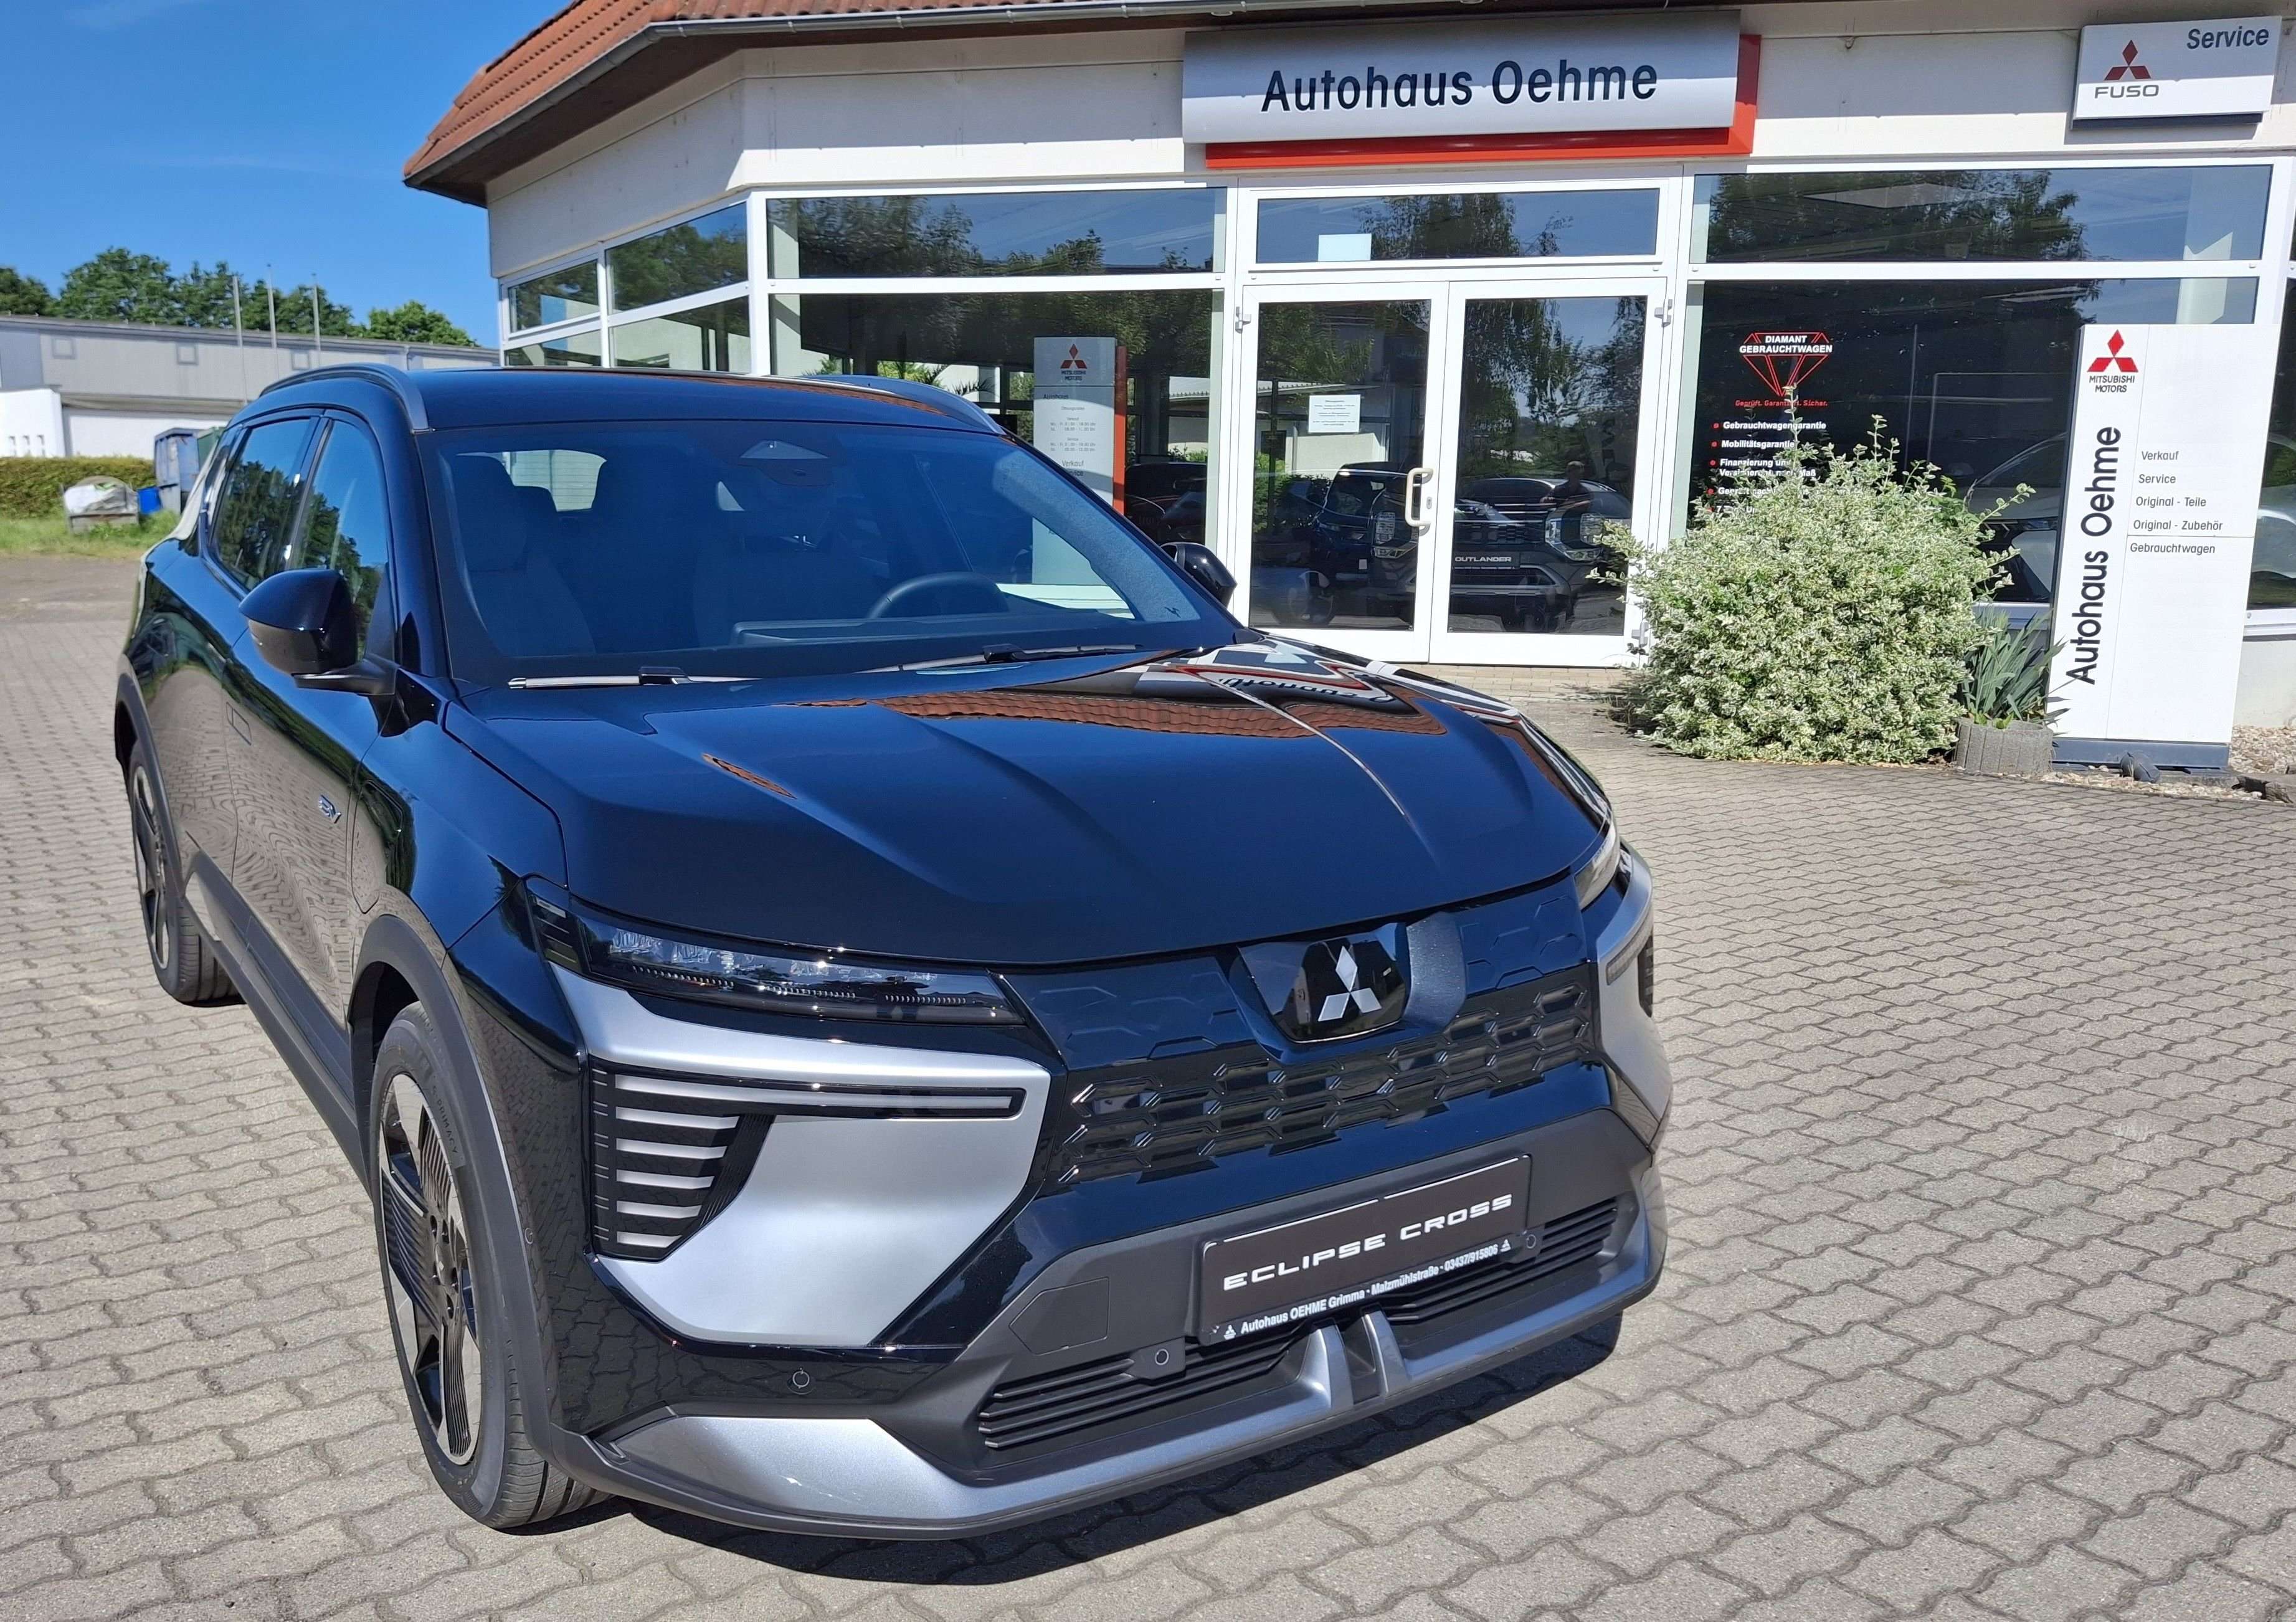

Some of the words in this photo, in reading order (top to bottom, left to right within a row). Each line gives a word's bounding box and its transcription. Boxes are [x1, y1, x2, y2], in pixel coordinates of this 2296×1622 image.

[2186, 26, 2270, 49] Service
[1260, 67, 1473, 112] Autohaus
[1491, 59, 1658, 104] Oehme
[2094, 84, 2160, 99] FUSO
[1765, 335, 1808, 343] DIAMANT
[1739, 344, 1833, 353] GEBRAUCHTWAGEN
[2089, 375, 2135, 383] MITSUBISHI
[1723, 421, 1827, 431] Gebrauchtwagengarantie
[1721, 440, 1795, 449] Mobilitätsgarantie
[2142, 450, 2180, 460] Verkauf
[2080, 426, 2122, 537] Oehme
[2138, 474, 2176, 484] Service
[2136, 496, 2174, 508] Original
[2185, 497, 2206, 506] Teile
[2133, 519, 2171, 531] Original
[2181, 520, 2223, 530] Zubehör
[2130, 543, 2216, 556] Gebrauchtwagen
[2066, 550, 2109, 685] Autohaus
[1223, 1233, 1386, 1291] ECLIPSE
[1400, 1194, 1513, 1241] CROSS
[1240, 1312, 1288, 1334] Autohaus
[1289, 1299, 1327, 1320] OEHME
[1328, 1289, 1365, 1309] Grimma
